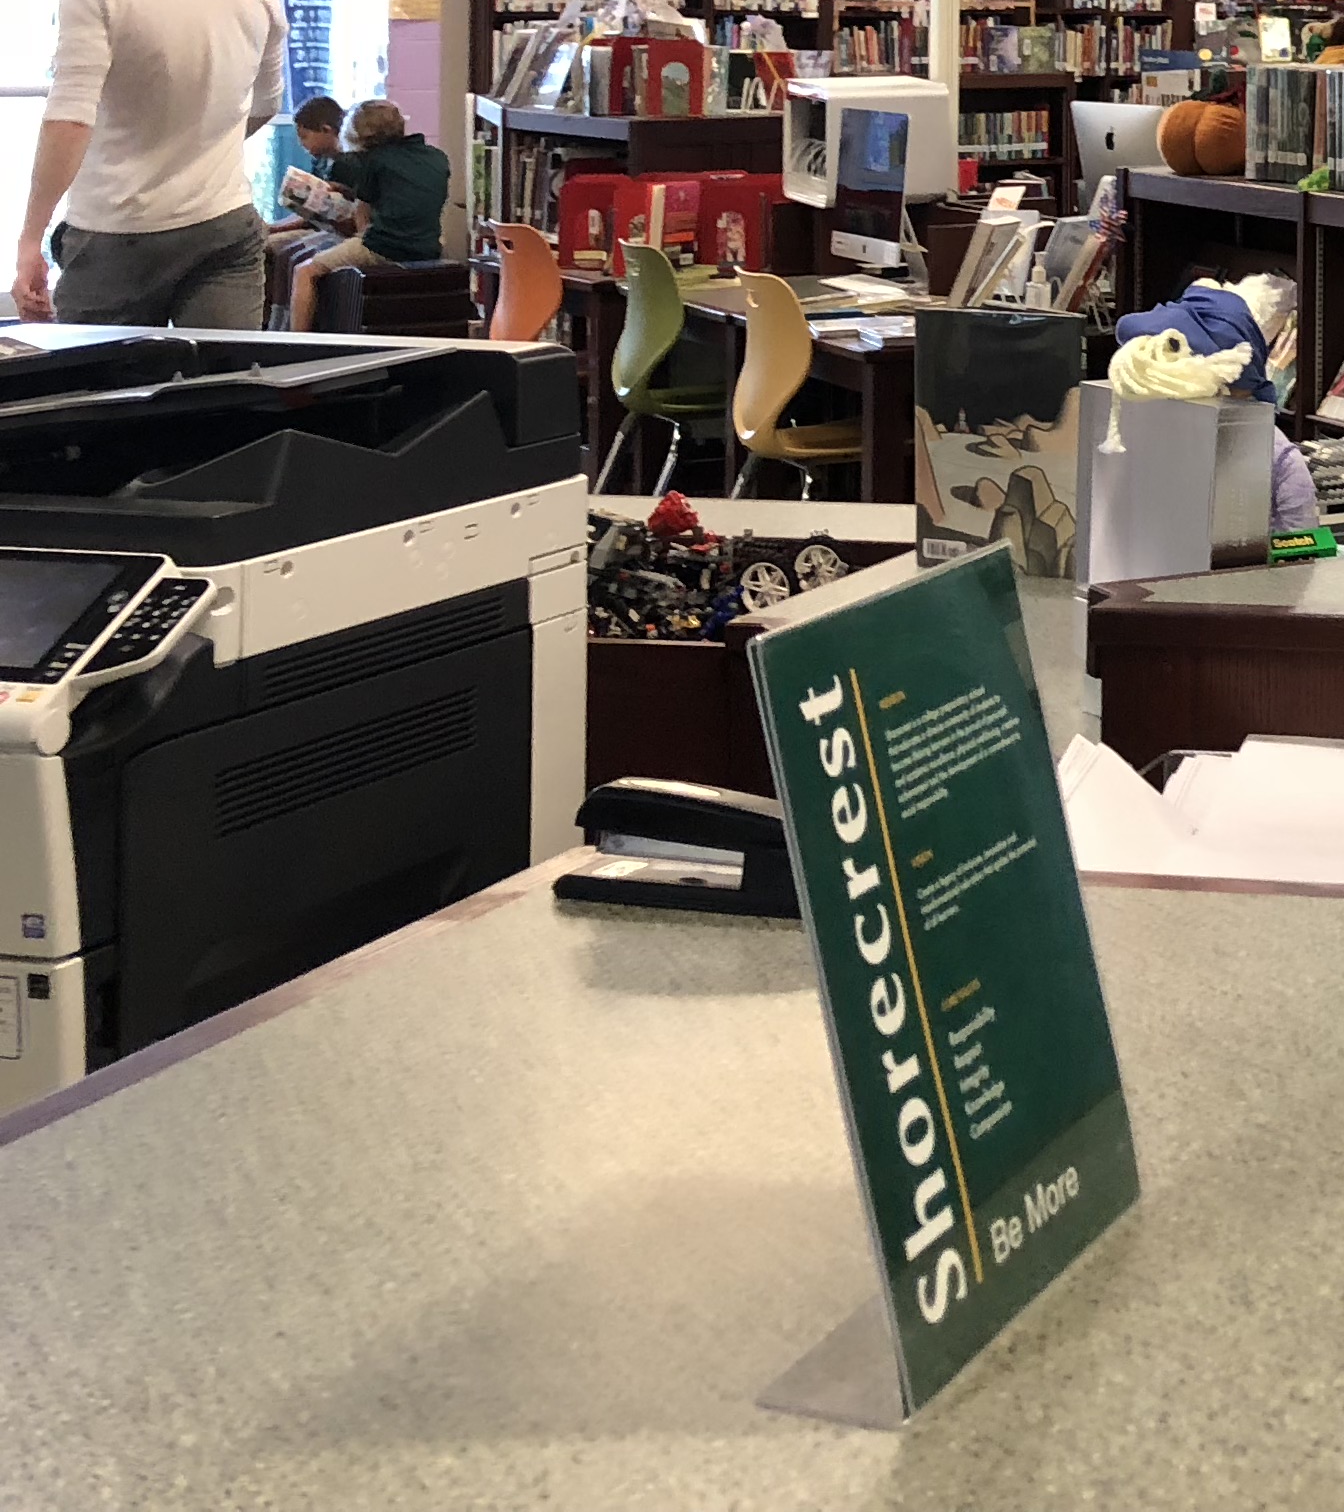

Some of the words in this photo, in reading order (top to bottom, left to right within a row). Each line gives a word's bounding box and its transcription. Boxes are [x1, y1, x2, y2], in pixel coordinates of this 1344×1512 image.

[1272, 535, 1315, 548] Scotch
[799, 674, 968, 1324] Shorecrest
[989, 1217, 1022, 1265] Be
[1022, 1165, 1081, 1236] More
